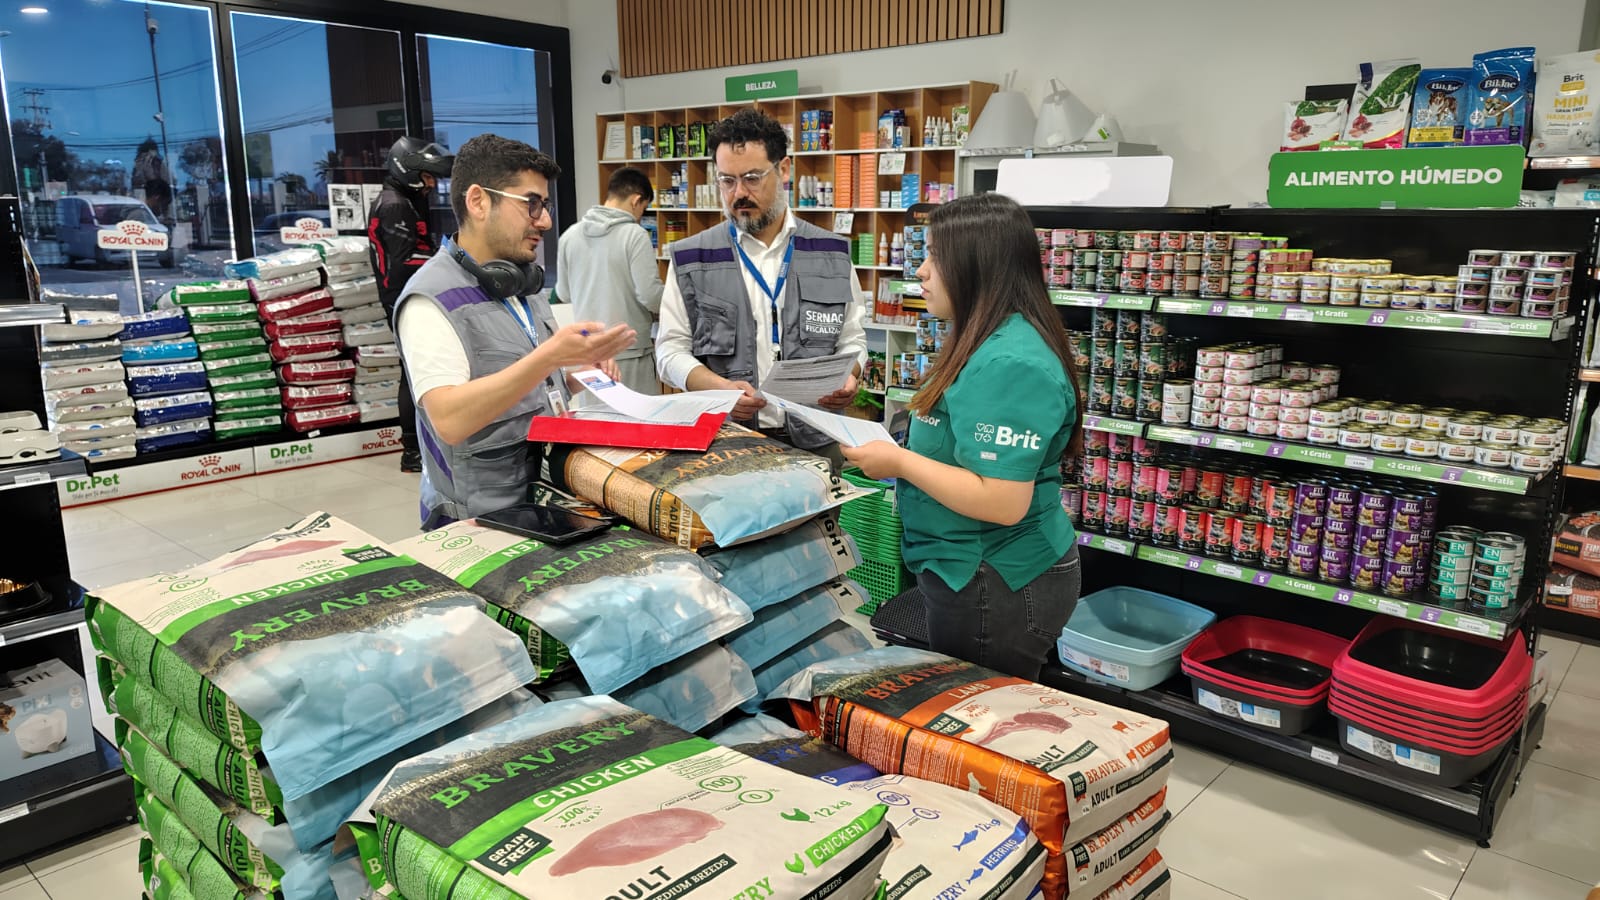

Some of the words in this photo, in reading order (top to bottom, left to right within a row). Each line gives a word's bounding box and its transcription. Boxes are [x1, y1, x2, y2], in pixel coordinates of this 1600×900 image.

[745, 80, 777, 92] BELLEZA
[1563, 73, 1585, 83] Brit
[1554, 95, 1588, 108] MINI
[1285, 170, 1394, 186] ALIMENTO
[1401, 165, 1503, 185] HÚMEDO
[103, 236, 132, 245] ROYAL
[134, 237, 165, 247] CANIN
[284, 232, 308, 241] ROYAL
[805, 310, 844, 324] SERNAC
[1324, 310, 1348, 319] Gratis
[1372, 315, 1384, 324] 10
[1416, 315, 1442, 325] Gratis
[1510, 322, 1538, 331] Gratis
[1116, 422, 1134, 430] Gratis
[362, 441, 385, 450] ROYAL
[995, 426, 1042, 450] Brit
[270, 443, 313, 459] Dr.Pet
[1200, 436, 1210, 445] 10
[1309, 450, 1332, 460] Gratis
[1398, 463, 1422, 473] Gratis
[1449, 473, 1456, 481] 5
[1487, 474, 1514, 486] Gratis
[180, 469, 209, 481] ROYAL
[211, 463, 241, 475] CANIN
[66, 473, 120, 493] Dr.Pet
[1337, 492, 1350, 500] FIT
[1369, 497, 1381, 505] FIT
[1405, 502, 1418, 510] FIT
[1332, 521, 1343, 529] FIT
[819, 514, 848, 556] IGHT
[1451, 543, 1465, 551] EN
[1485, 548, 1499, 557] EN
[1401, 565, 1412, 573] FIT
[1441, 557, 1455, 565] EN
[1496, 565, 1509, 573] EN
[1189, 560, 1199, 568] 10
[1259, 575, 1265, 583] 5
[1293, 581, 1316, 591] Gratis
[1338, 594, 1349, 602] 10
[1440, 571, 1454, 579] EN
[230, 570, 350, 605] CHICKEN
[1442, 586, 1456, 594] EN
[1492, 580, 1505, 588] EN
[1488, 595, 1502, 603] EN
[229, 578, 431, 651] BRAVERY
[949, 683, 992, 700] LAMB
[228, 700, 244, 747] CHICKE
[1138, 741, 1156, 755] LAMB
[430, 722, 635, 809] BRAVERY
[1085, 759, 1127, 784] BRAVERY
[532, 755, 657, 809] CHICKEN
[704, 776, 735, 789] 100
[1091, 786, 1115, 808] ADULT
[815, 807, 833, 818] 12
[833, 800, 852, 812] kg
[488, 833, 529, 862] GRAIN
[812, 825, 864, 861] CHICKEN
[497, 838, 541, 868] FREE
[985, 838, 1017, 867] HERRING
[692, 857, 729, 884] BREEDS
[1093, 853, 1118, 877] ADULT
[818, 876, 844, 896] BREEDS
